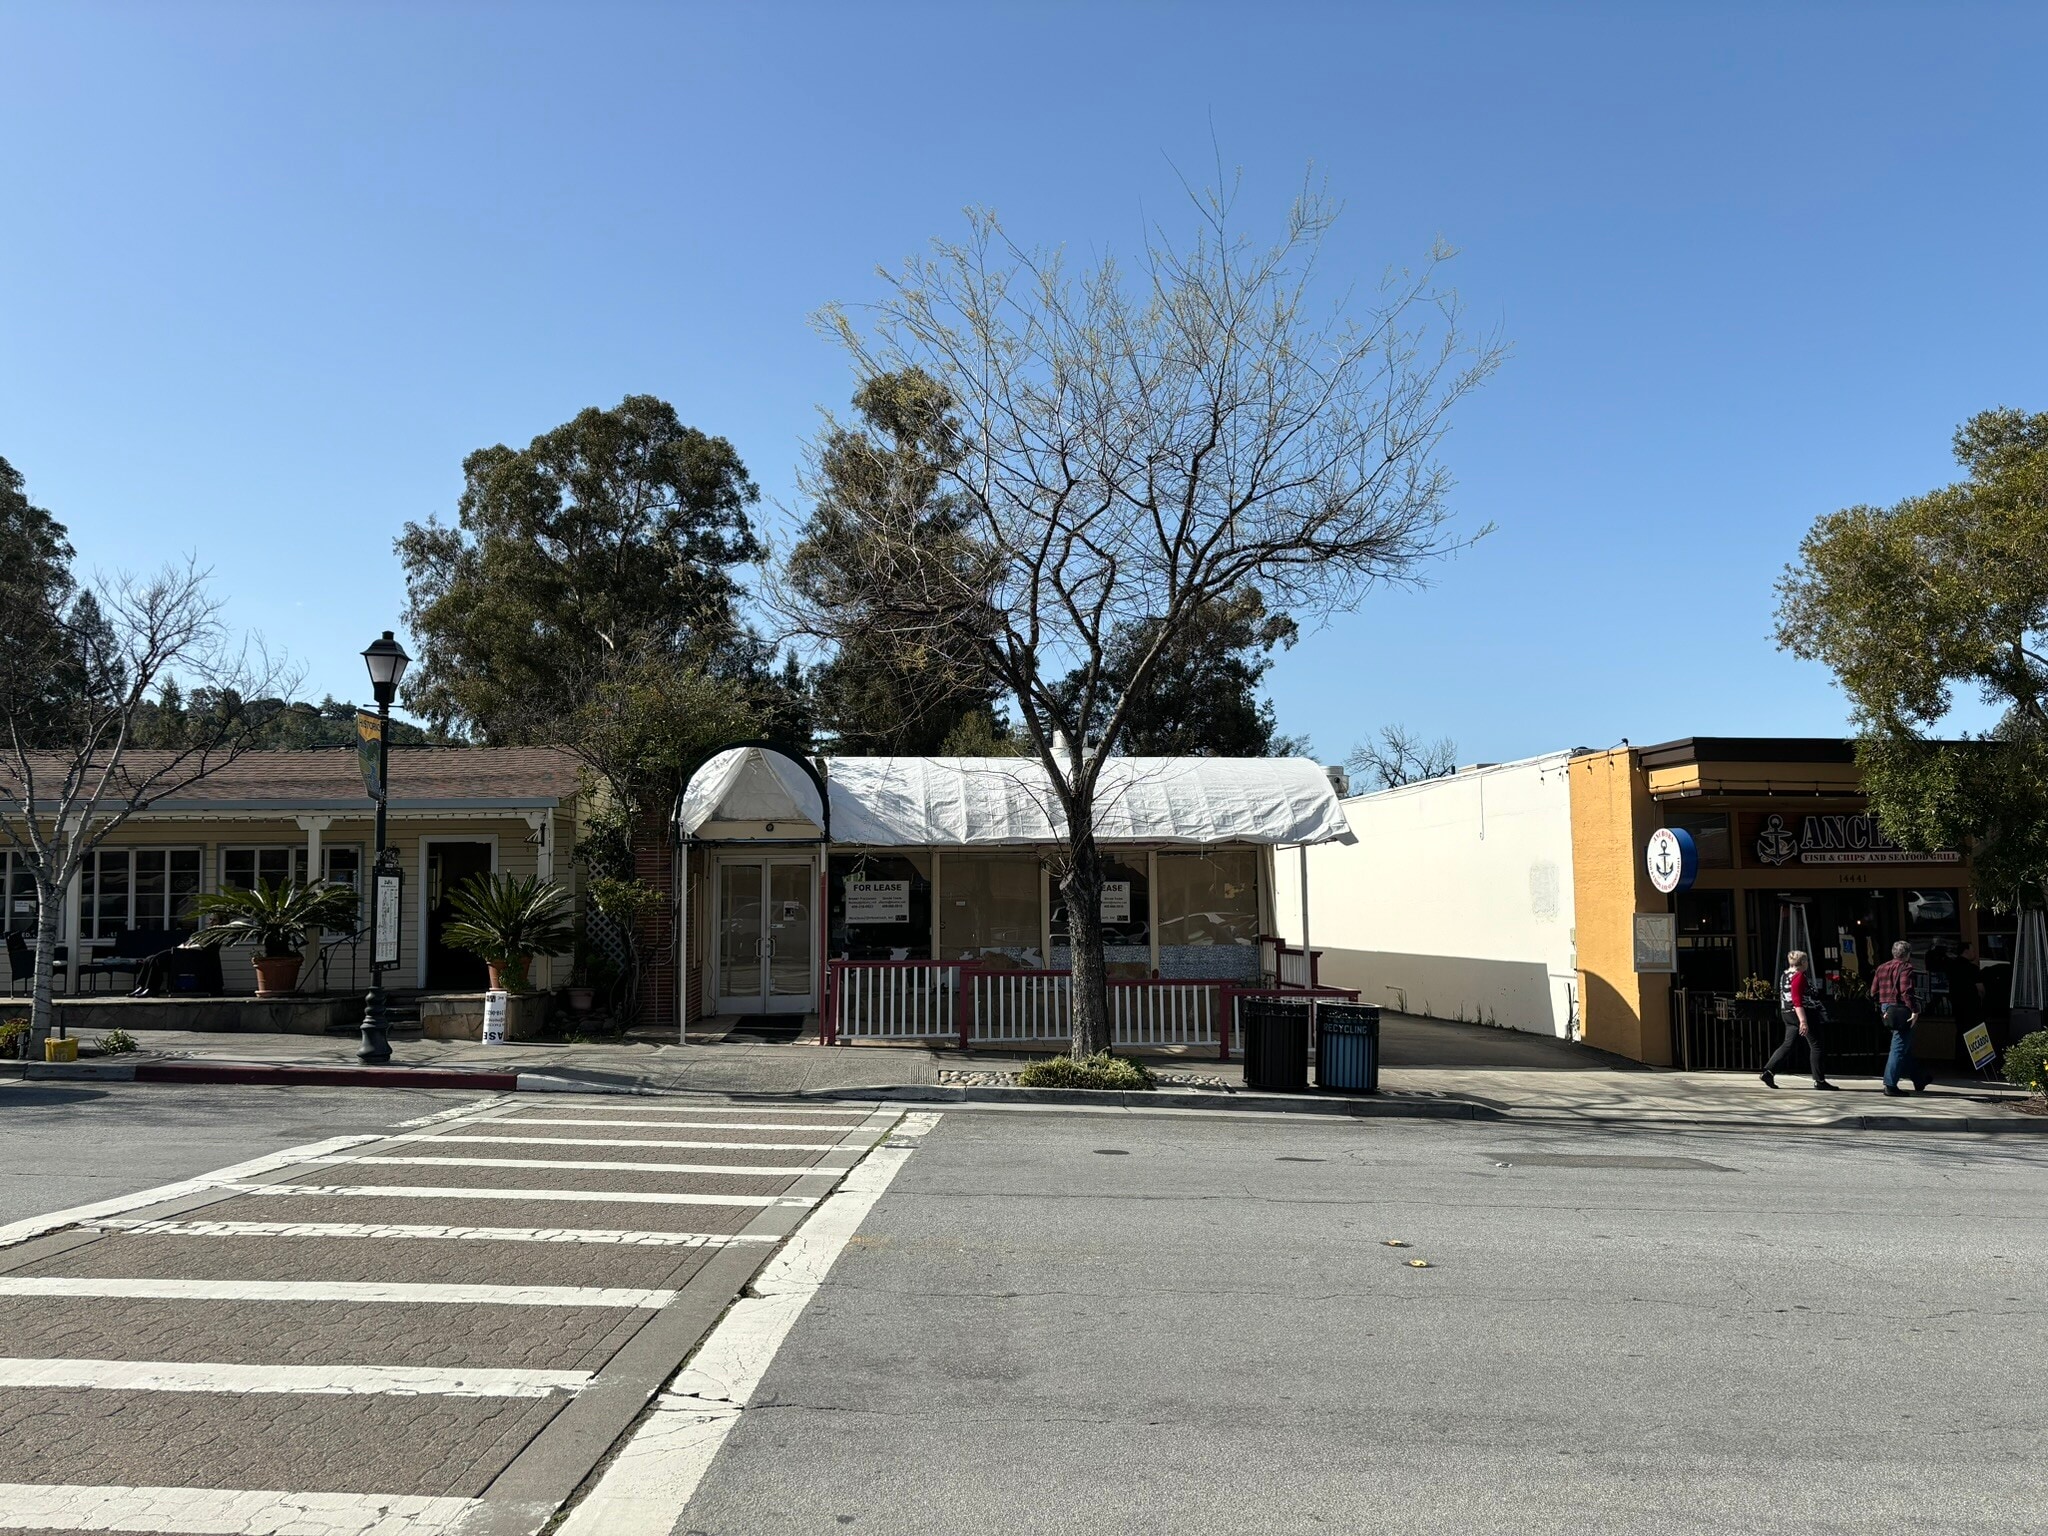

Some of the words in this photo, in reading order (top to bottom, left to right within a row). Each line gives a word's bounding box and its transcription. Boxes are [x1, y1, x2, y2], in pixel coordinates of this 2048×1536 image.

[1800, 815, 1959, 848] ANCH
[1932, 853, 1957, 861] GRILL
[1839, 874, 1868, 883] 14441
[1324, 1023, 1367, 1034] RECYCLING
